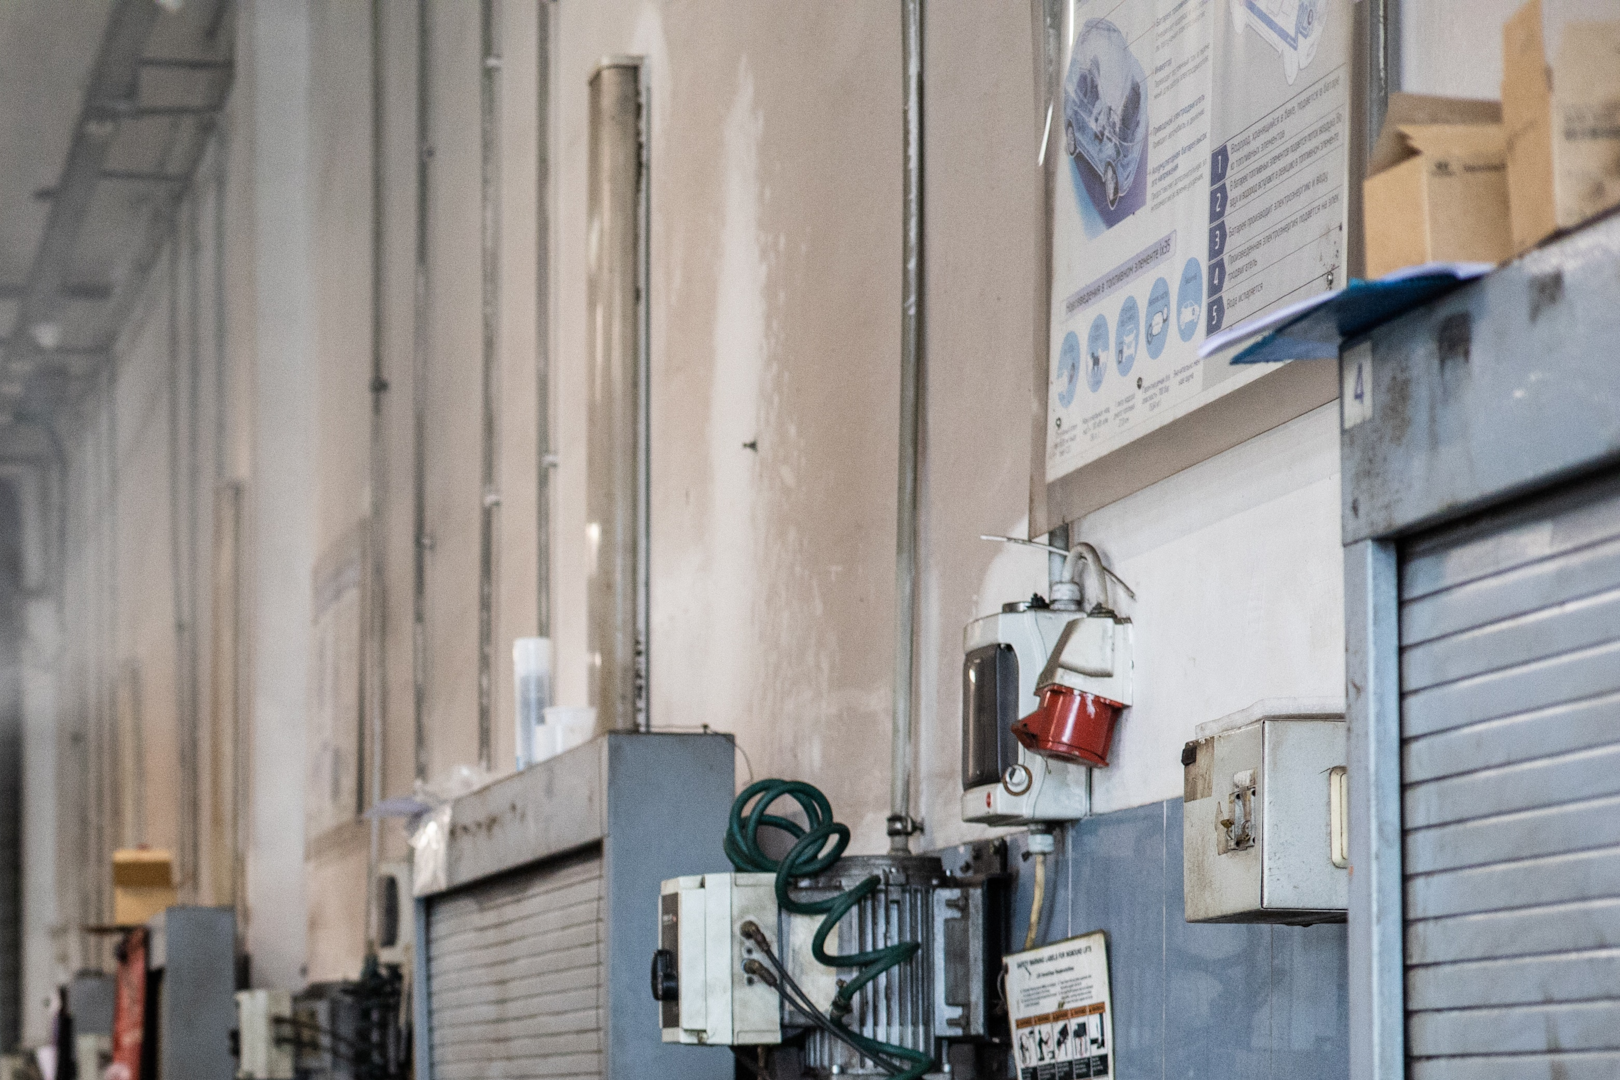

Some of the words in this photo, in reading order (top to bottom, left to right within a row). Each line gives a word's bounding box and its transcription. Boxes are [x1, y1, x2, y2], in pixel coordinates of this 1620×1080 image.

[1218, 155, 1222, 174] 1
[1215, 193, 1221, 212] 2
[1215, 230, 1220, 250] 3
[1213, 267, 1219, 285] 4
[1212, 305, 1218, 325] 5
[1354, 362, 1364, 404] 4
